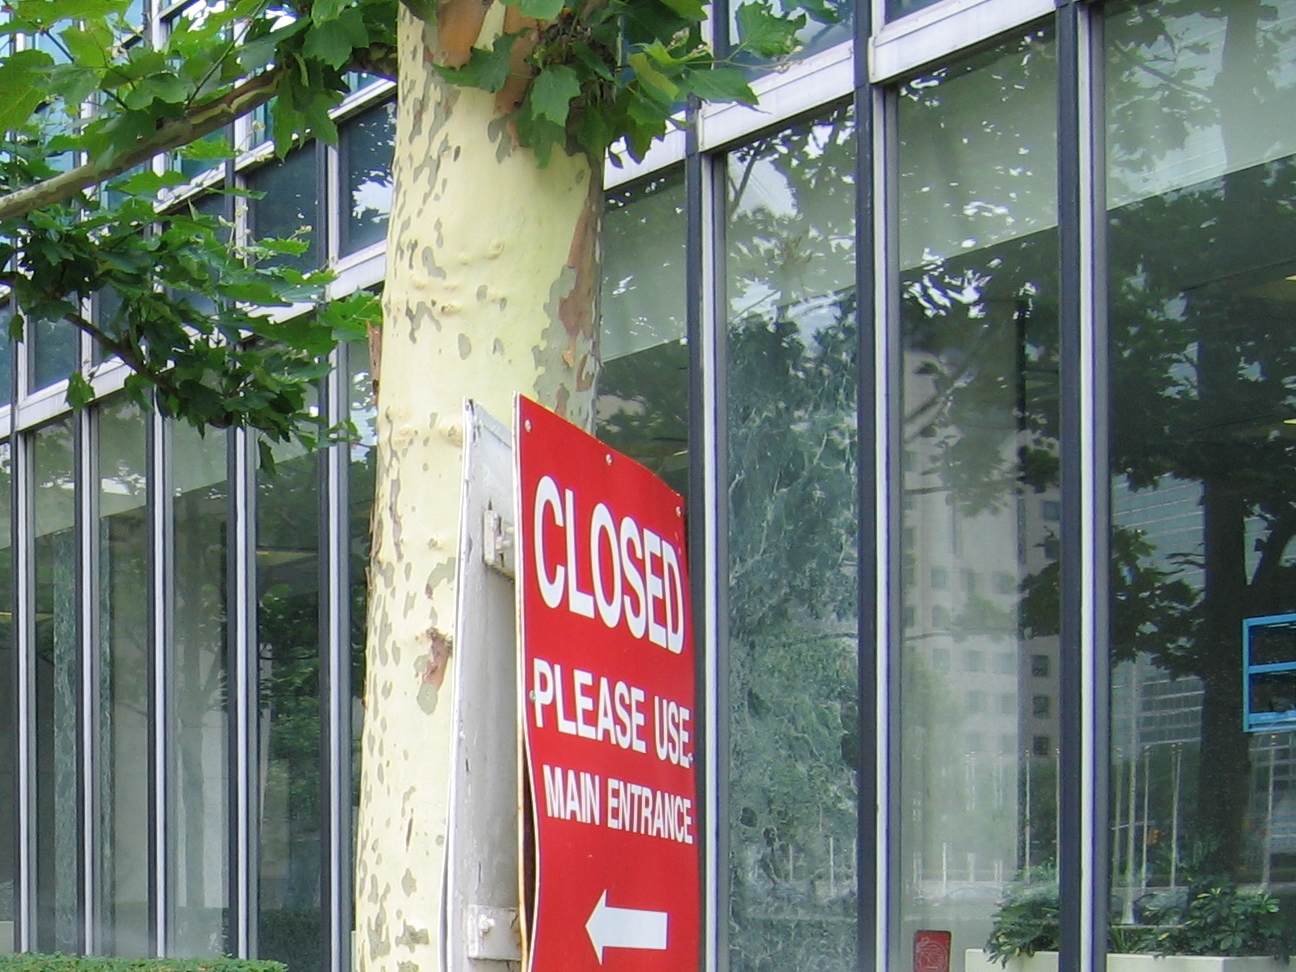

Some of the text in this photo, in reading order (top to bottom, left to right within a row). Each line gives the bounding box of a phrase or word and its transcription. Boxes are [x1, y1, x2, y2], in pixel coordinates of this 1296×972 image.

[533, 475, 685, 655] CLOSED
[533, 658, 691, 768] PLEASE USE
[543, 765, 694, 844] MAIN ENTRANCE
